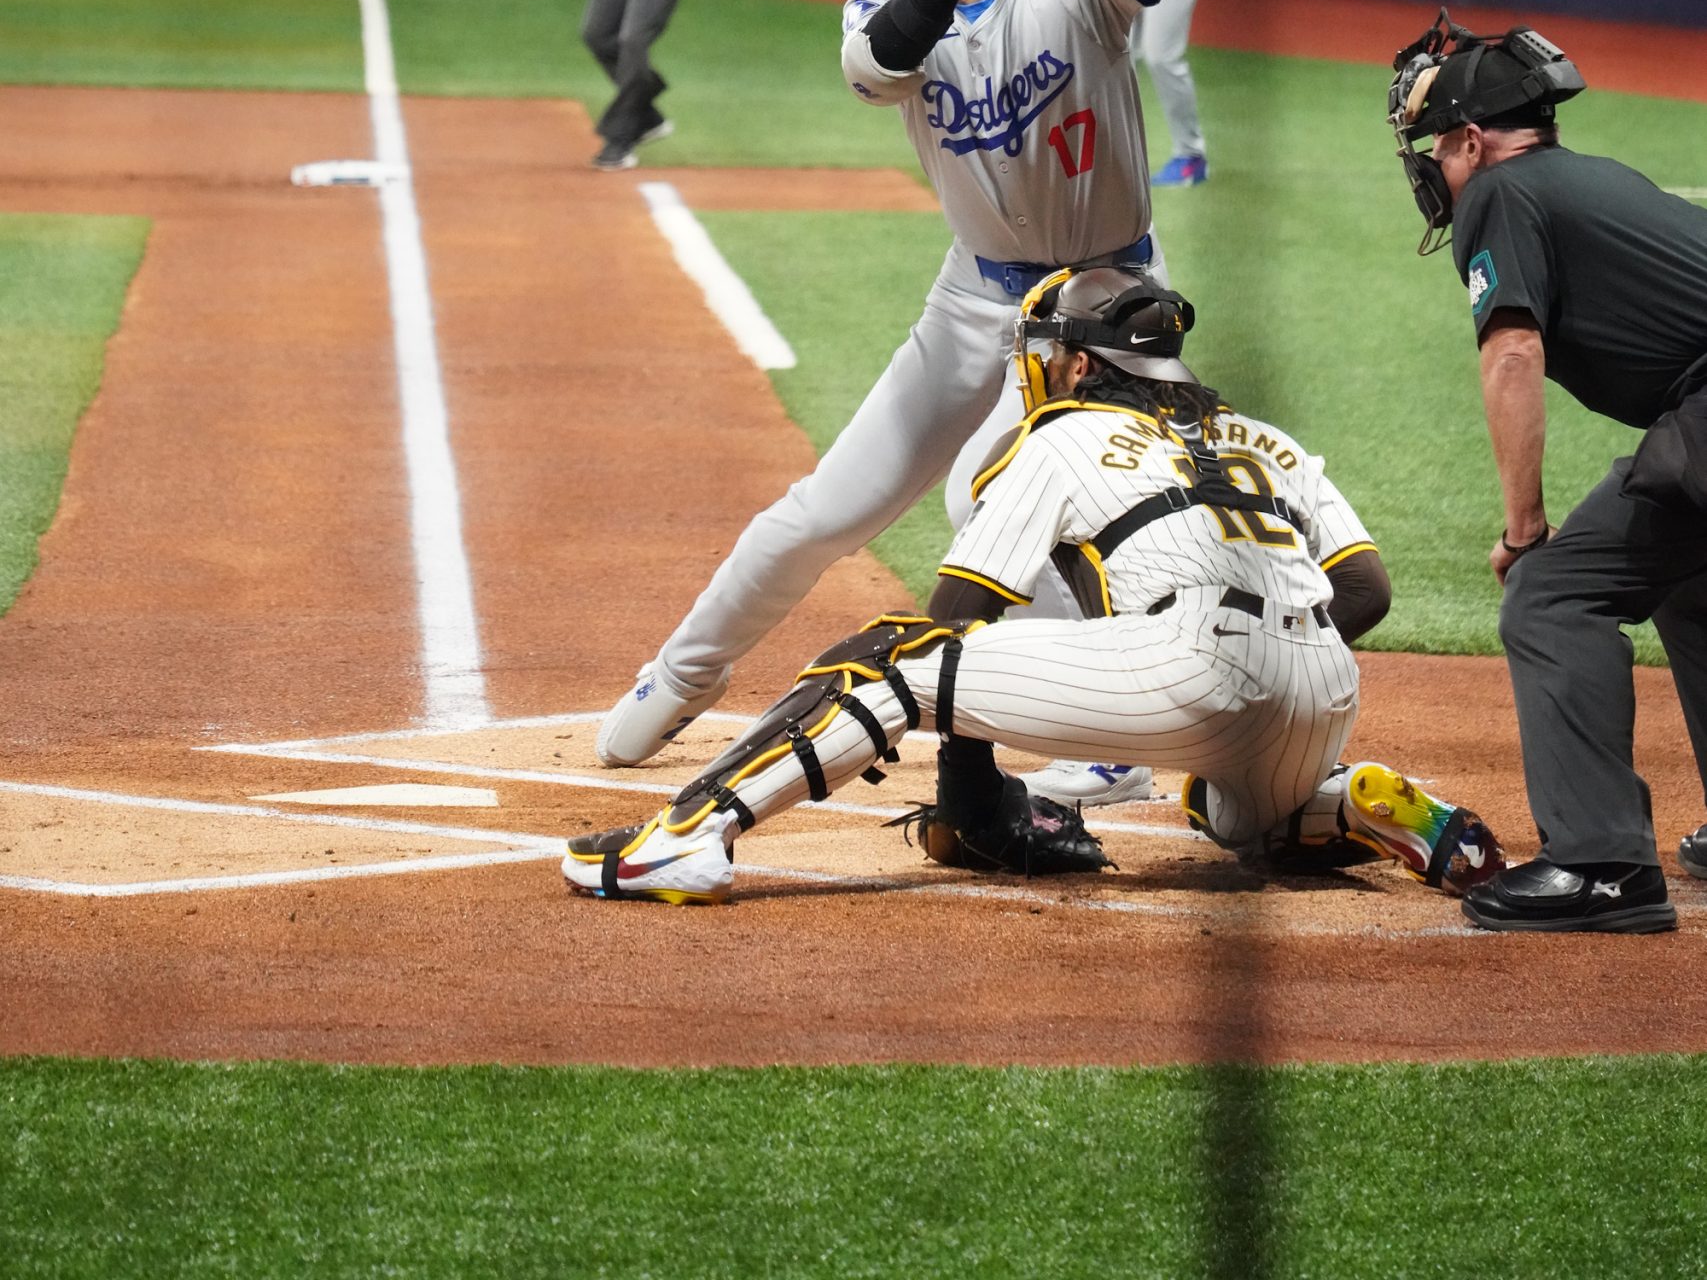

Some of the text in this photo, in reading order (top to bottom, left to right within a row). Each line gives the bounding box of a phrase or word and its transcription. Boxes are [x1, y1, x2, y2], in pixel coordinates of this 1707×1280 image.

[921, 50, 1075, 157] Dodgers
[1048, 108, 1096, 179] 17
[1101, 419, 1298, 471] CAMSANO
[1170, 453, 1300, 550] 12
